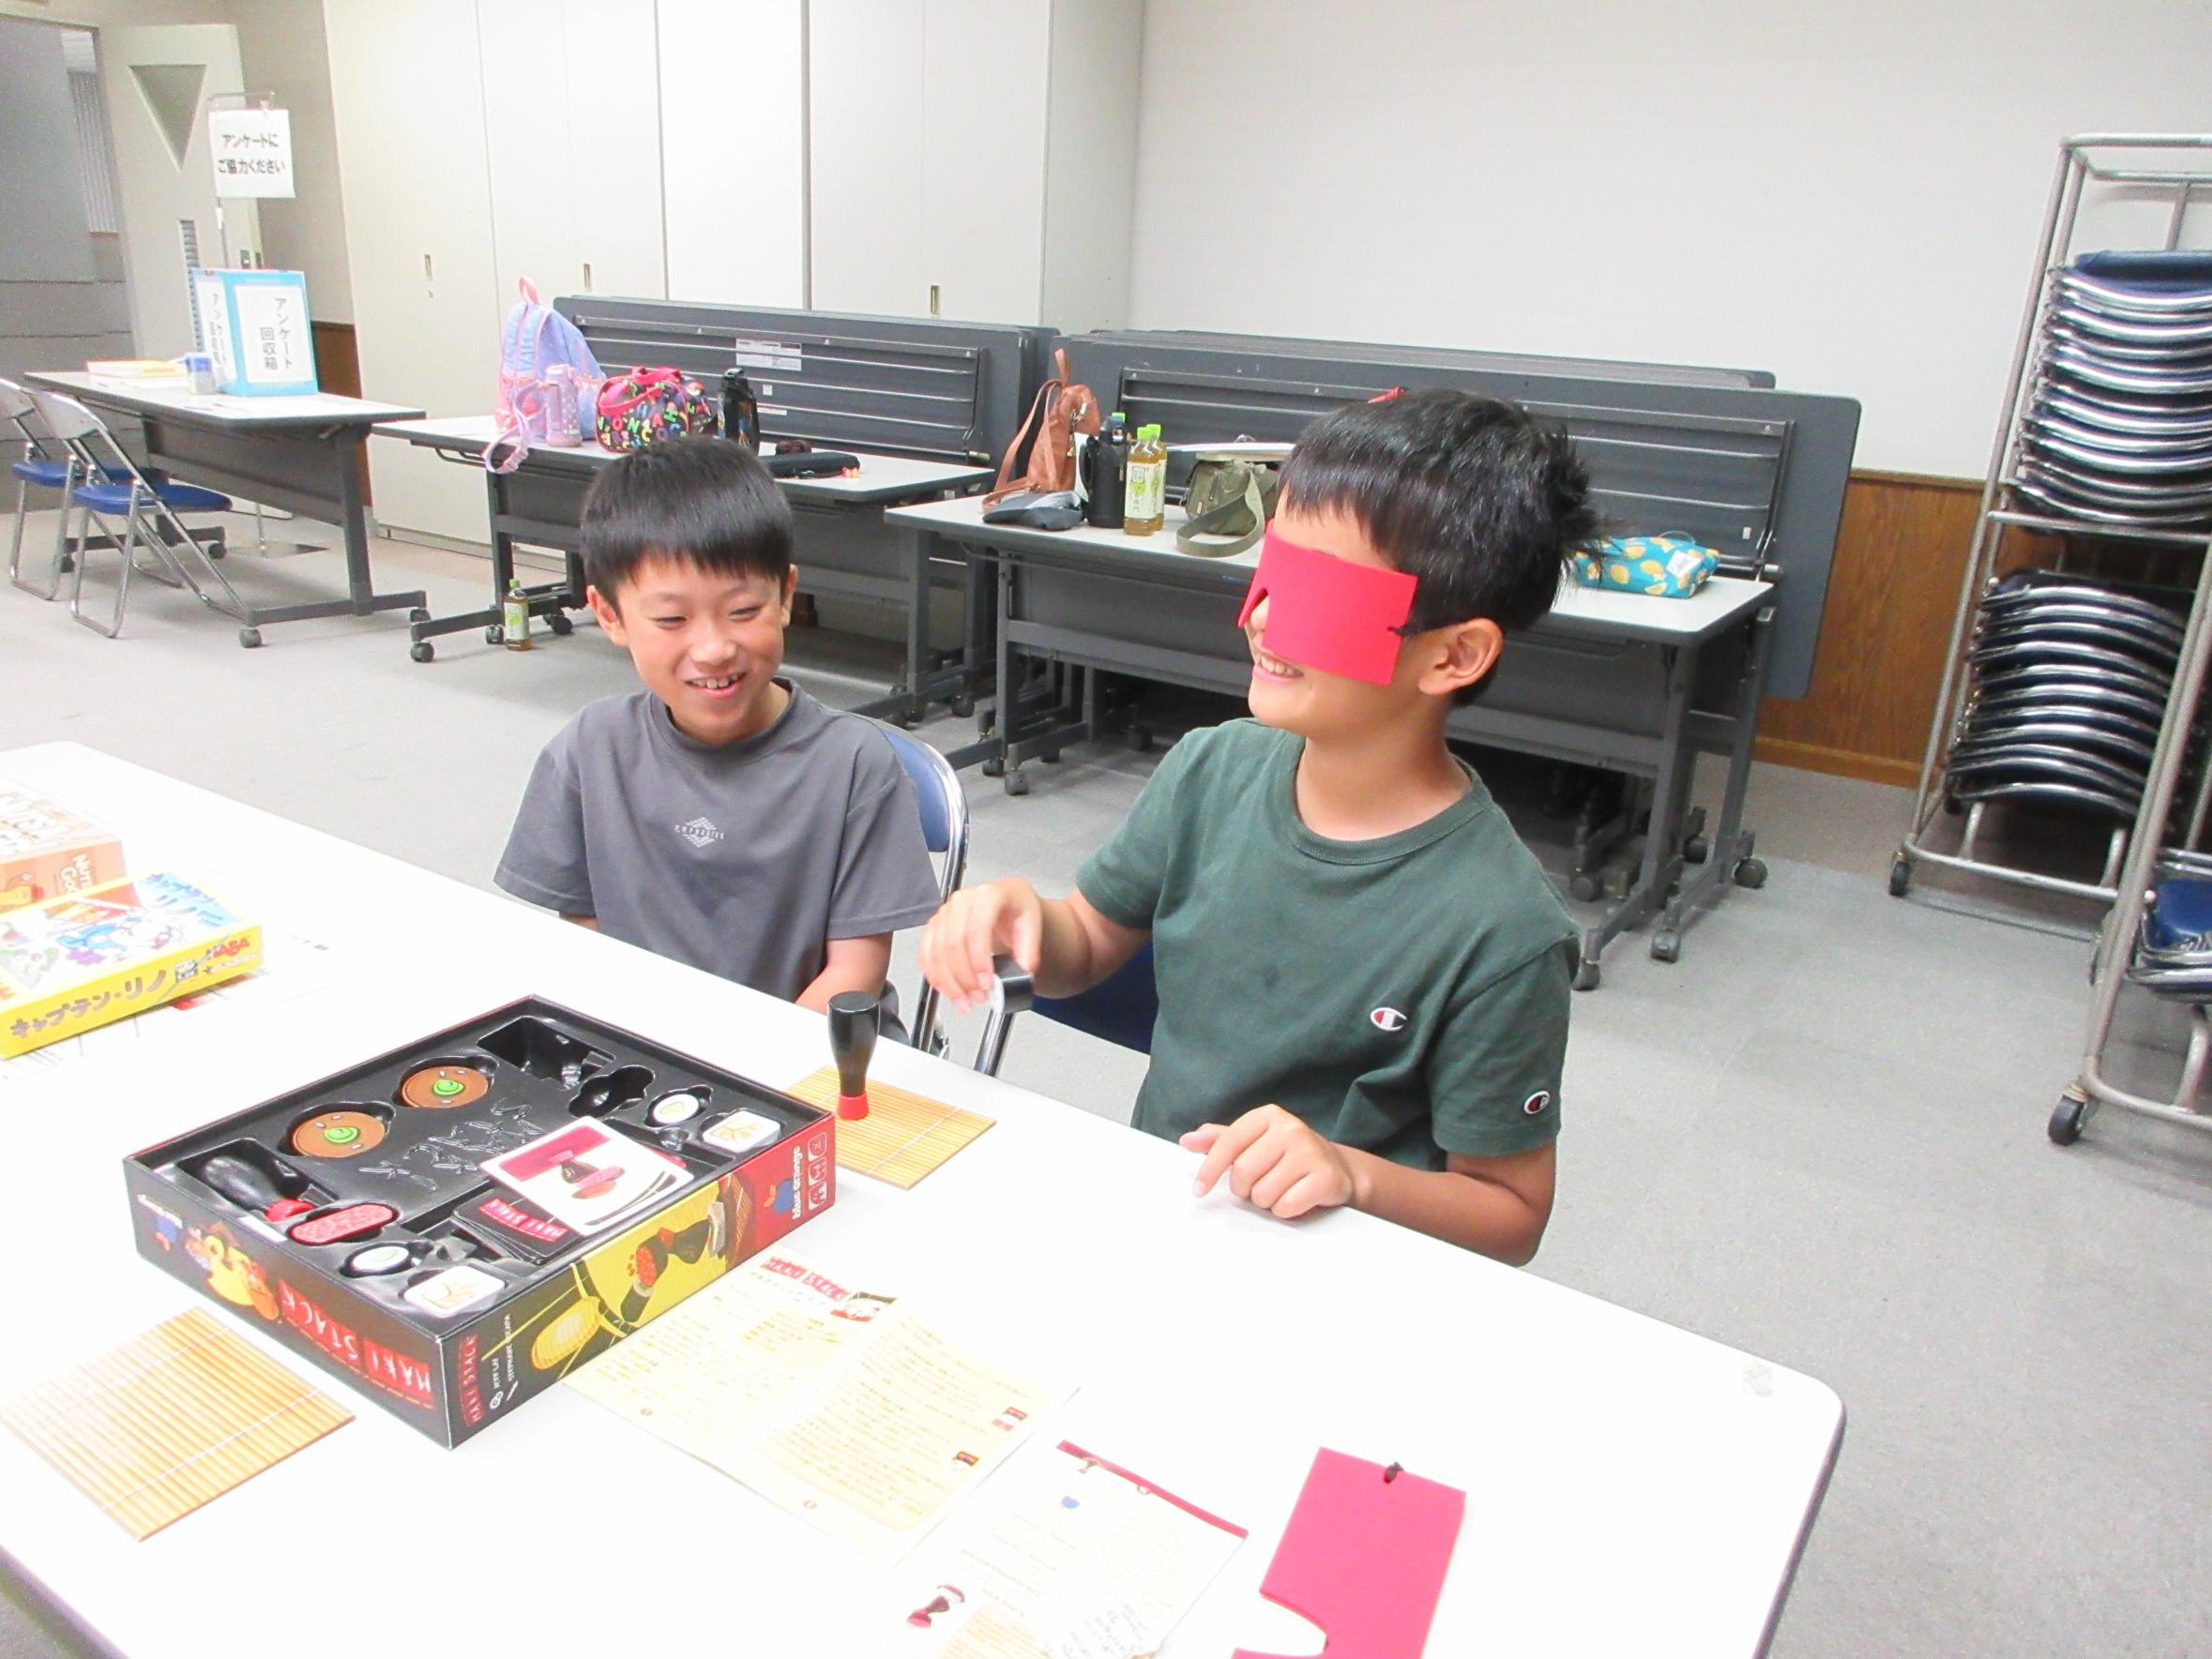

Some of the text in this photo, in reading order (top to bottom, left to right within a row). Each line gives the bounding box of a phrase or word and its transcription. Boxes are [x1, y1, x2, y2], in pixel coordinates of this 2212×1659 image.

[221, 133, 279, 149] アンケートに
[218, 158, 285, 175] ご協力ください
[260, 326, 278, 370] 回収箱
[275, 297, 293, 370] アンケート
[793, 1145, 803, 1192] orange
[281, 1285, 432, 1393] MAKI STACK
[462, 1335, 483, 1423] MAKI STACK
